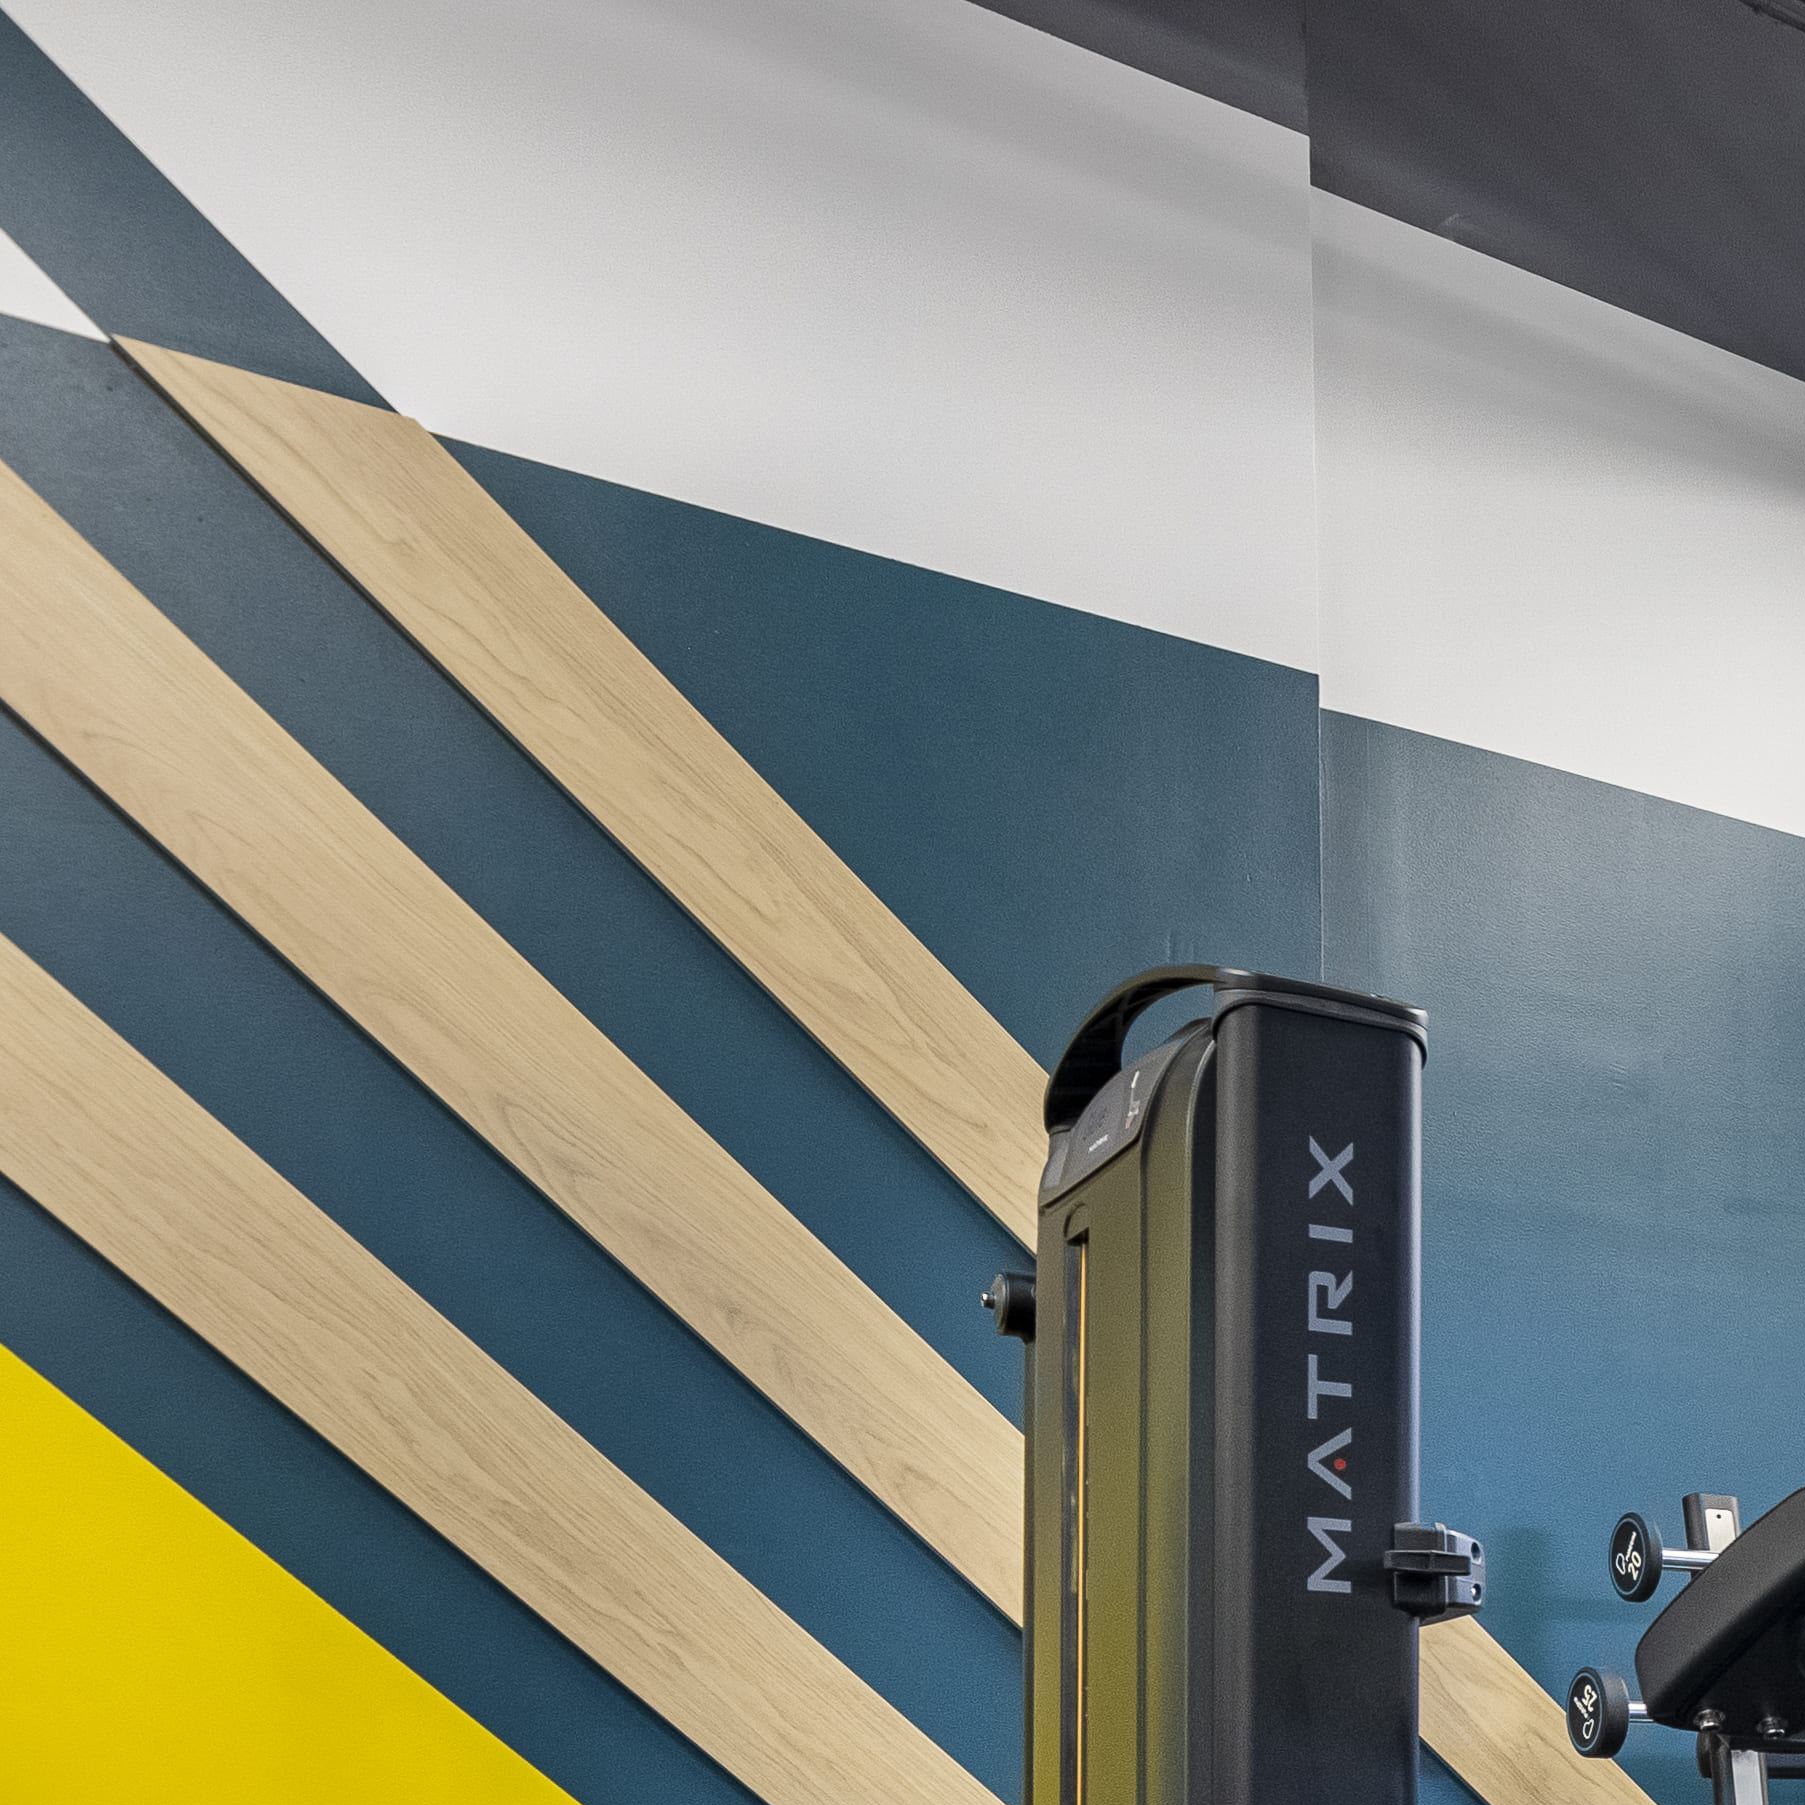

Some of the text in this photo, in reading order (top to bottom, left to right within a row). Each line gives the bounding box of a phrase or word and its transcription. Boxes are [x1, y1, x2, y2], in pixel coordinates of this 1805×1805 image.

[1306, 1135, 1355, 1594] MATRIX
[1628, 1551, 1641, 1581] 20
[1581, 1685, 1597, 1712] 25
